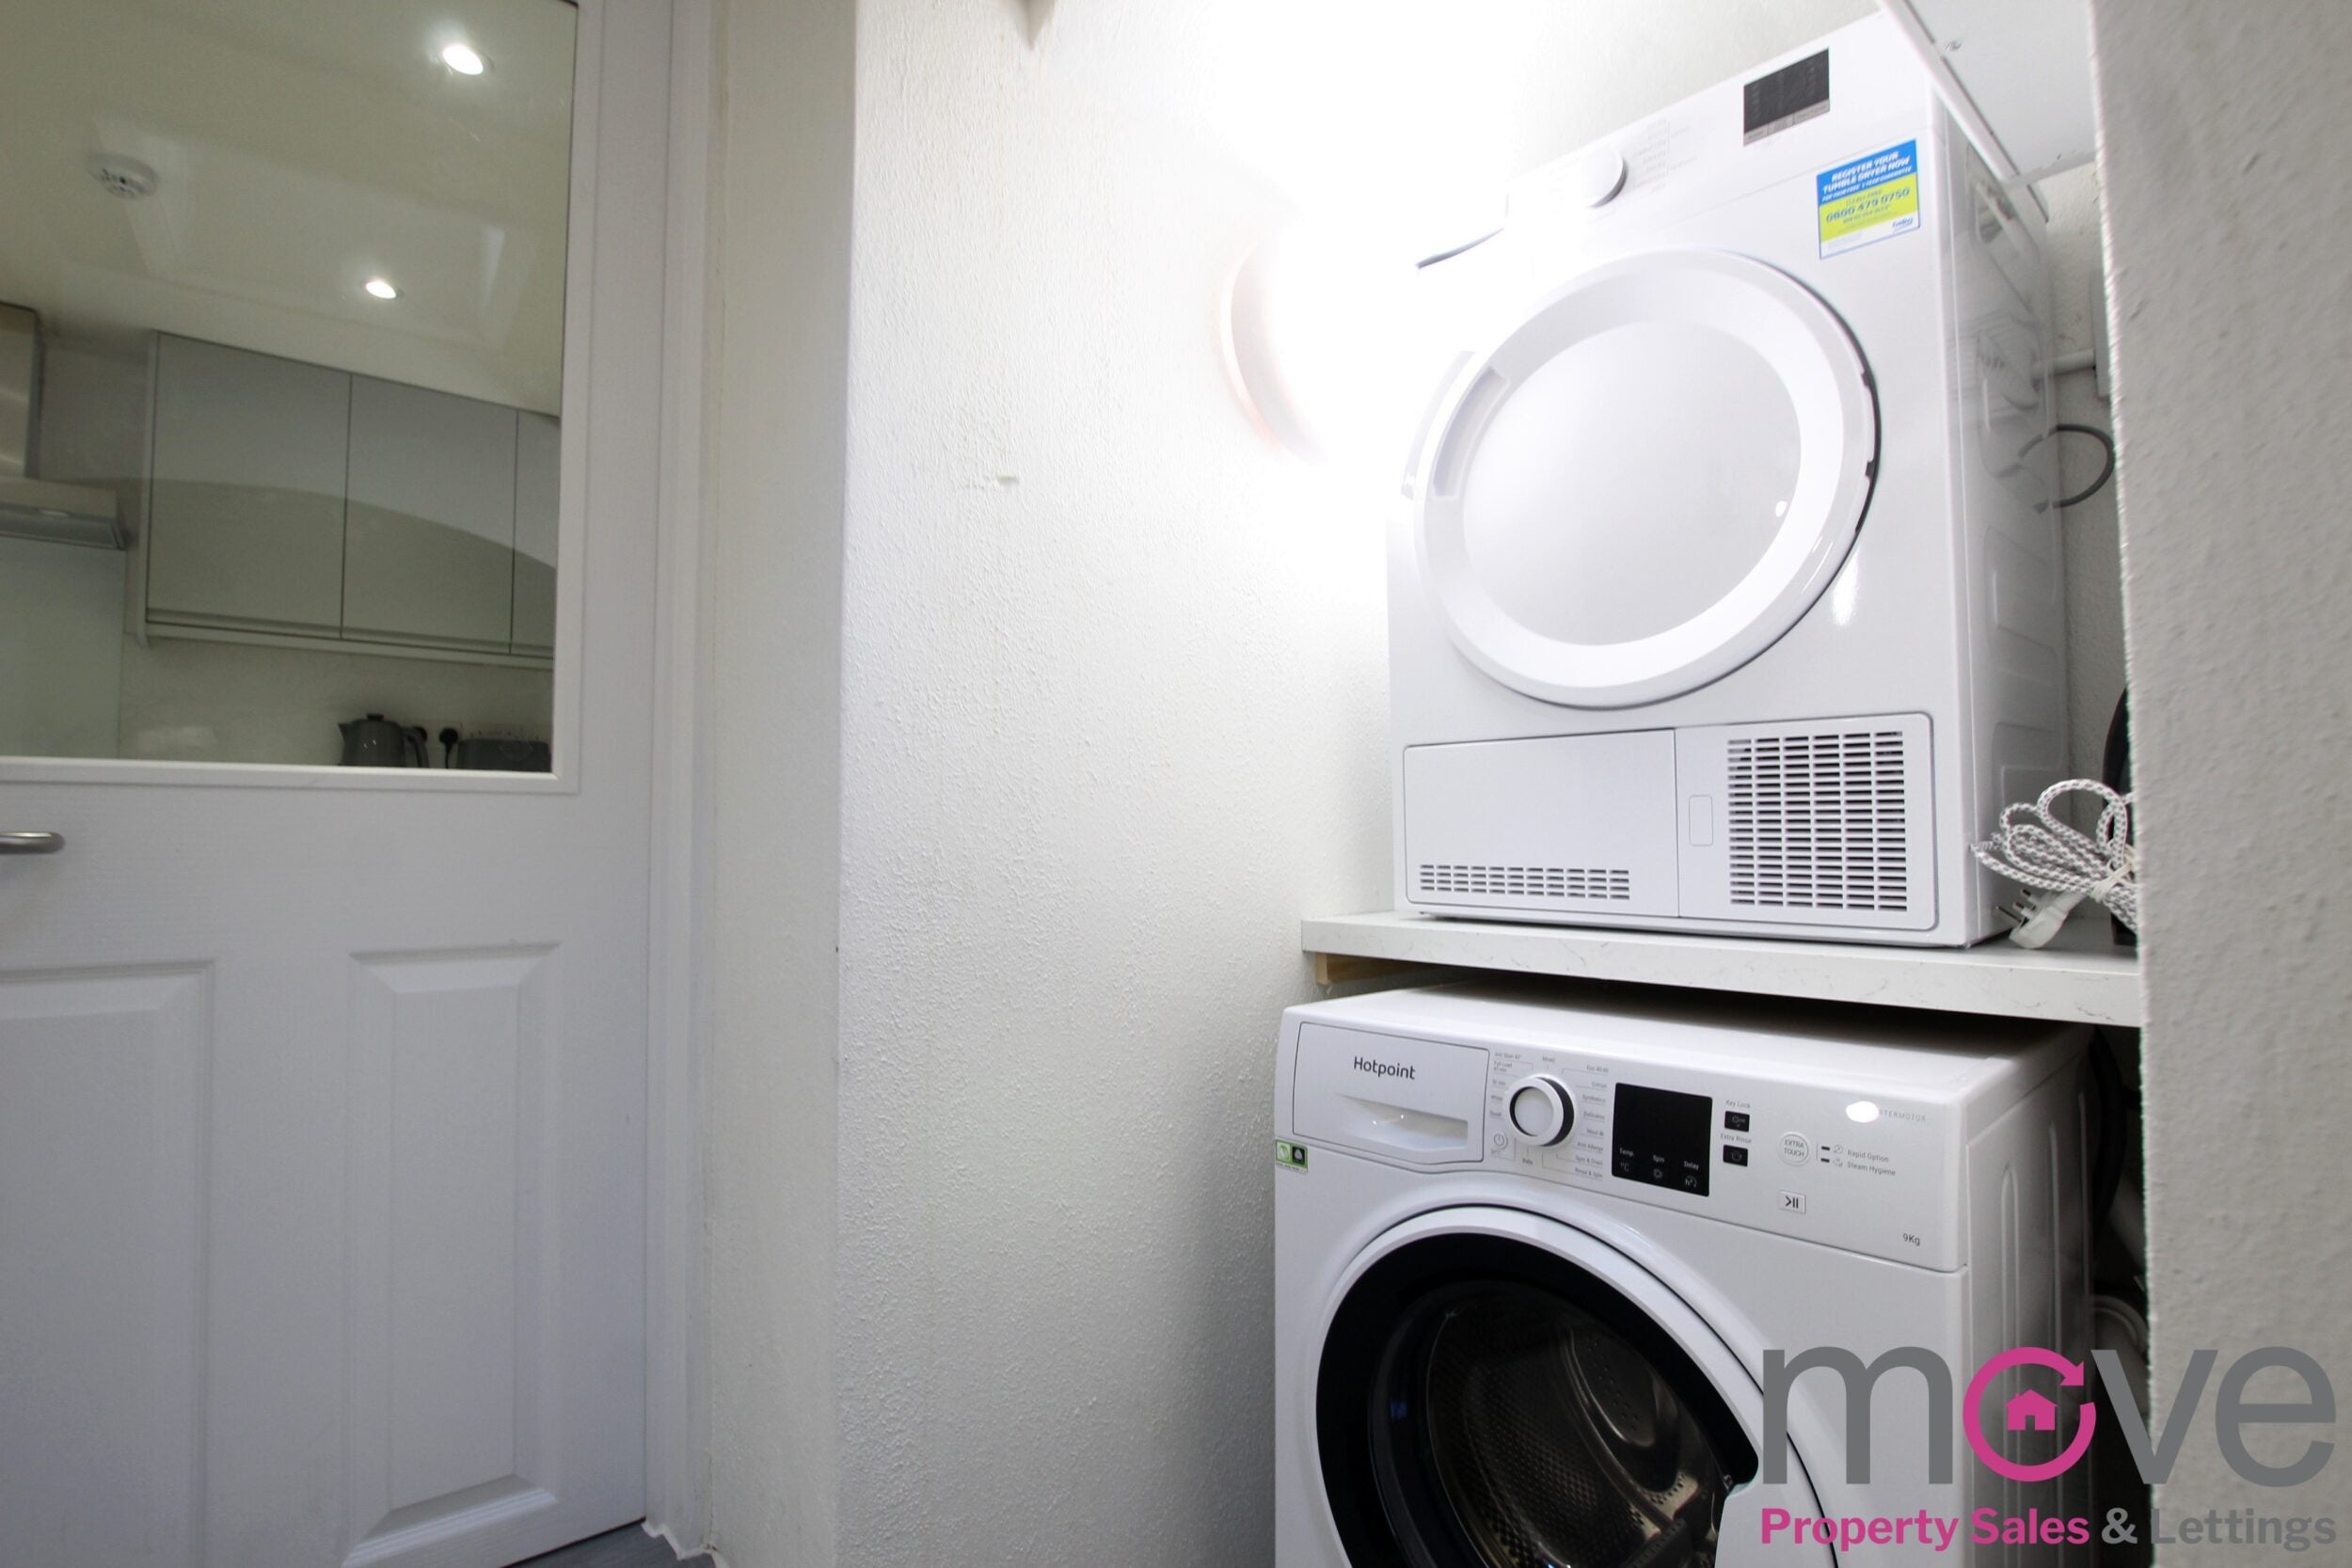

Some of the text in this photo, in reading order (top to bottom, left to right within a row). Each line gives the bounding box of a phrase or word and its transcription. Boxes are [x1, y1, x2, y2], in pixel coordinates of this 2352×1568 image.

[1831, 150, 1899, 182] REGISTER YOUR
[1823, 156, 1911, 194] TUMBLE DRYER NOW
[1826, 208, 1855, 223] 0800
[1881, 187, 1911, 204] 0750
[1353, 1054, 1416, 1081] Hotpoint
[1725, 1099, 1751, 1109] Key Lock
[1720, 1132, 1752, 1144] Extra Rinse
[1784, 1138, 1804, 1149] EXTRA
[1619, 1147, 1634, 1158] Temp
[1784, 1147, 1804, 1159] TOUCH
[1847, 1148, 1890, 1164] Rapid Option
[1683, 1160, 1700, 1171] Delay
[1847, 1160, 1897, 1177] Steam Hygiene
[1902, 1232, 1920, 1247] 9Kg
